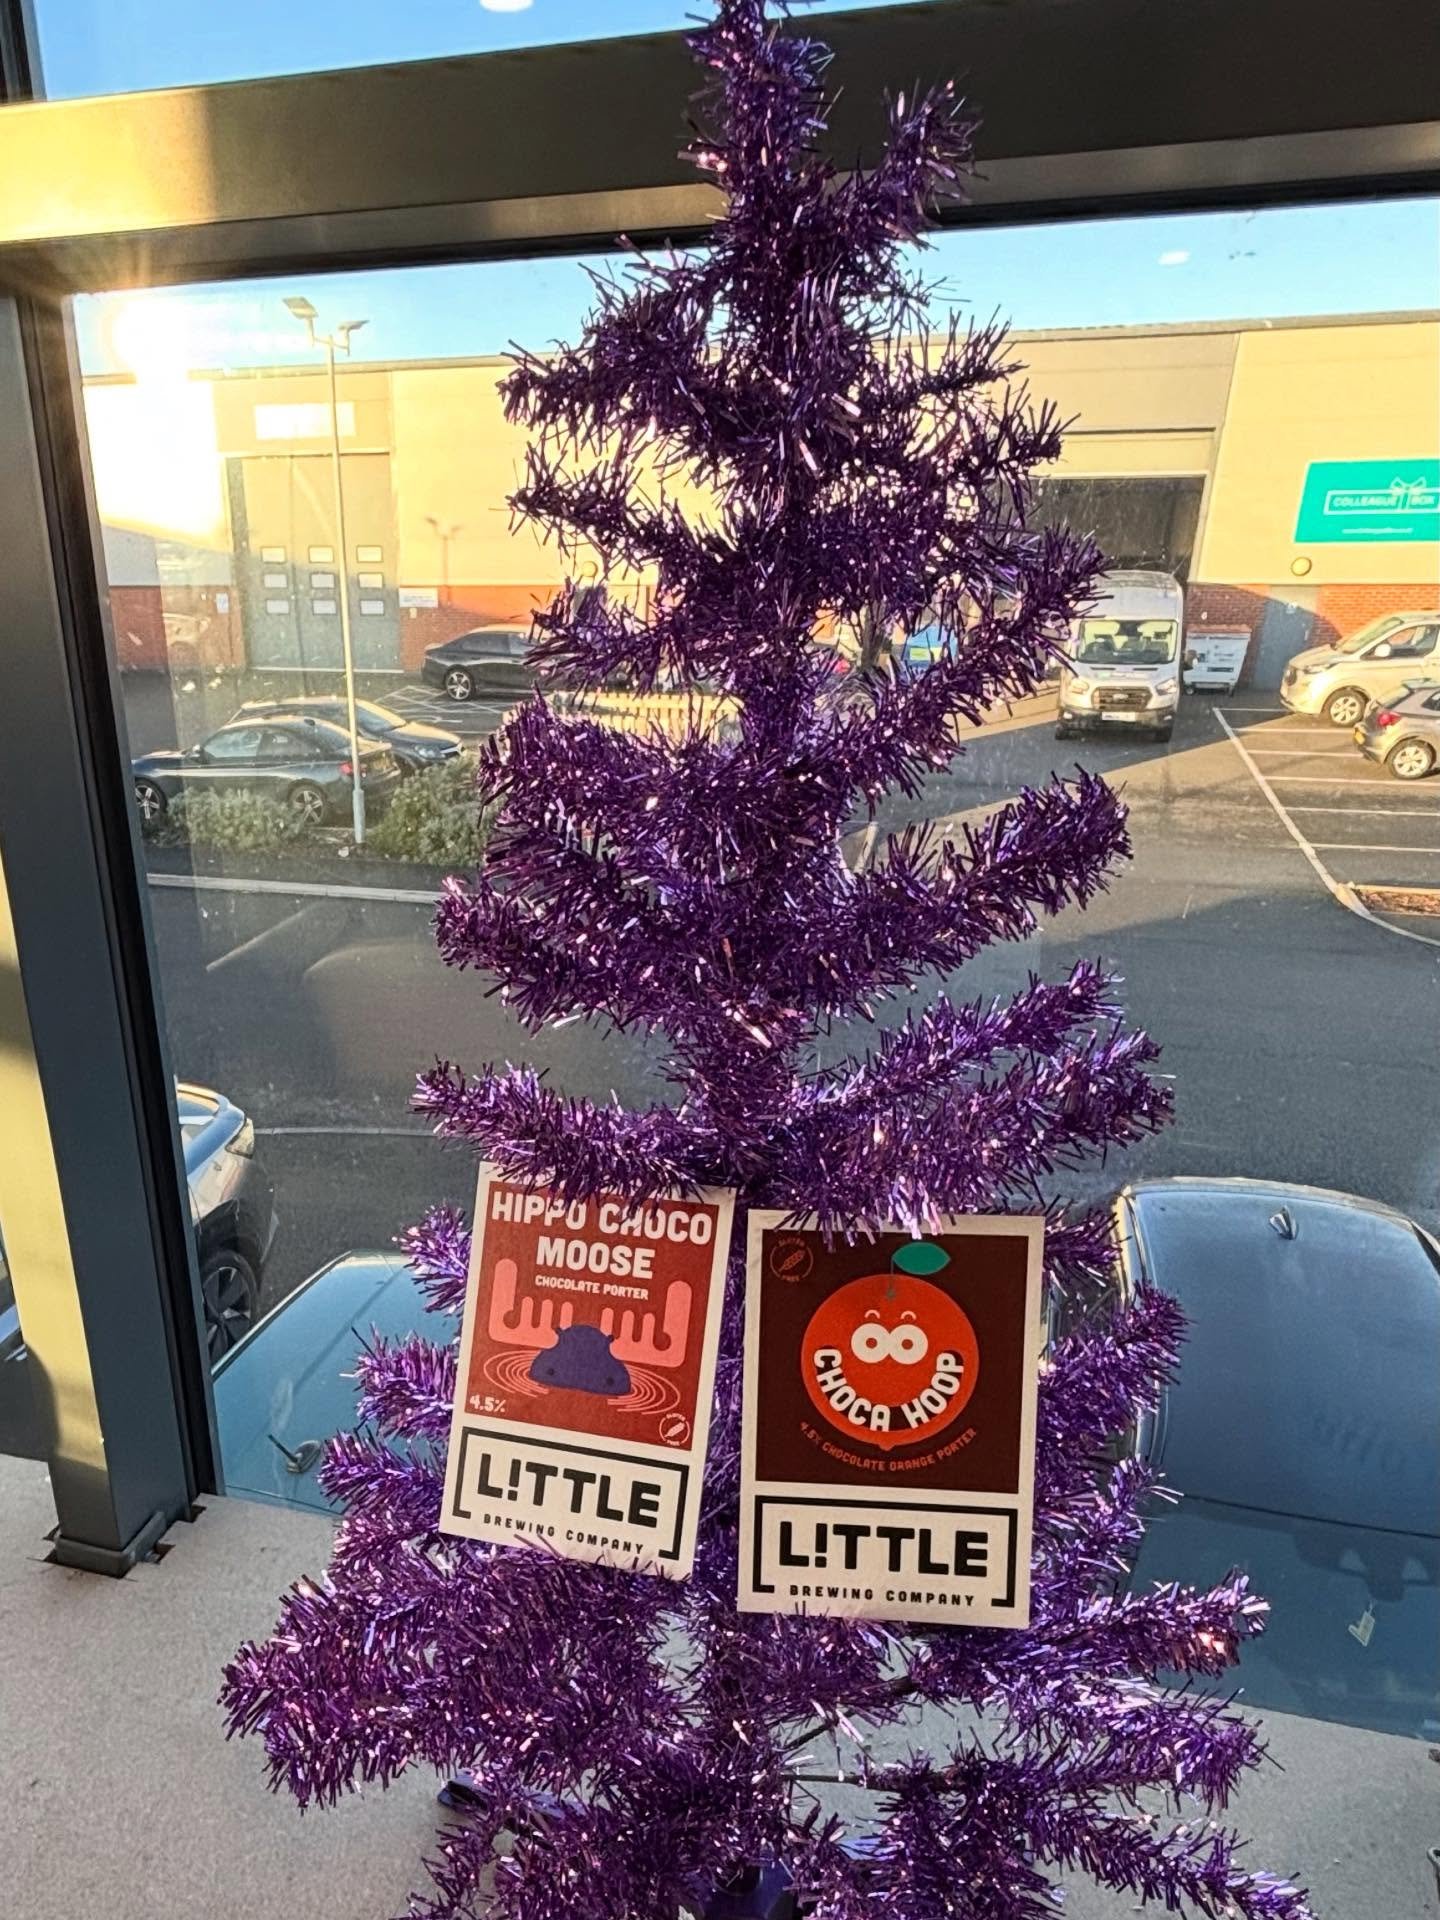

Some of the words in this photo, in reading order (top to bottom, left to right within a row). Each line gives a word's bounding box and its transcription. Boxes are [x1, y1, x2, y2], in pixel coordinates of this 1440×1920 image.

[491, 1191, 587, 1230] HIPPO
[598, 1202, 713, 1246] CHOCO
[535, 1235, 656, 1279] MOOSE
[534, 1275, 601, 1294] CHOCOLATE
[602, 1283, 649, 1300] PORTER
[469, 1394, 507, 1413] 4.5%
[813, 1348, 891, 1433] CHOCA
[900, 1352, 965, 1429] HOOP
[821, 1441, 887, 1472] CHOCOLATE
[889, 1457, 937, 1472] ORANGE
[936, 1427, 978, 1462] PORTER
[482, 1513, 556, 1538] BREWING
[565, 1528, 645, 1556] COMPANY
[789, 1584, 874, 1601] BREWING
[885, 1590, 975, 1607] COMPANY
